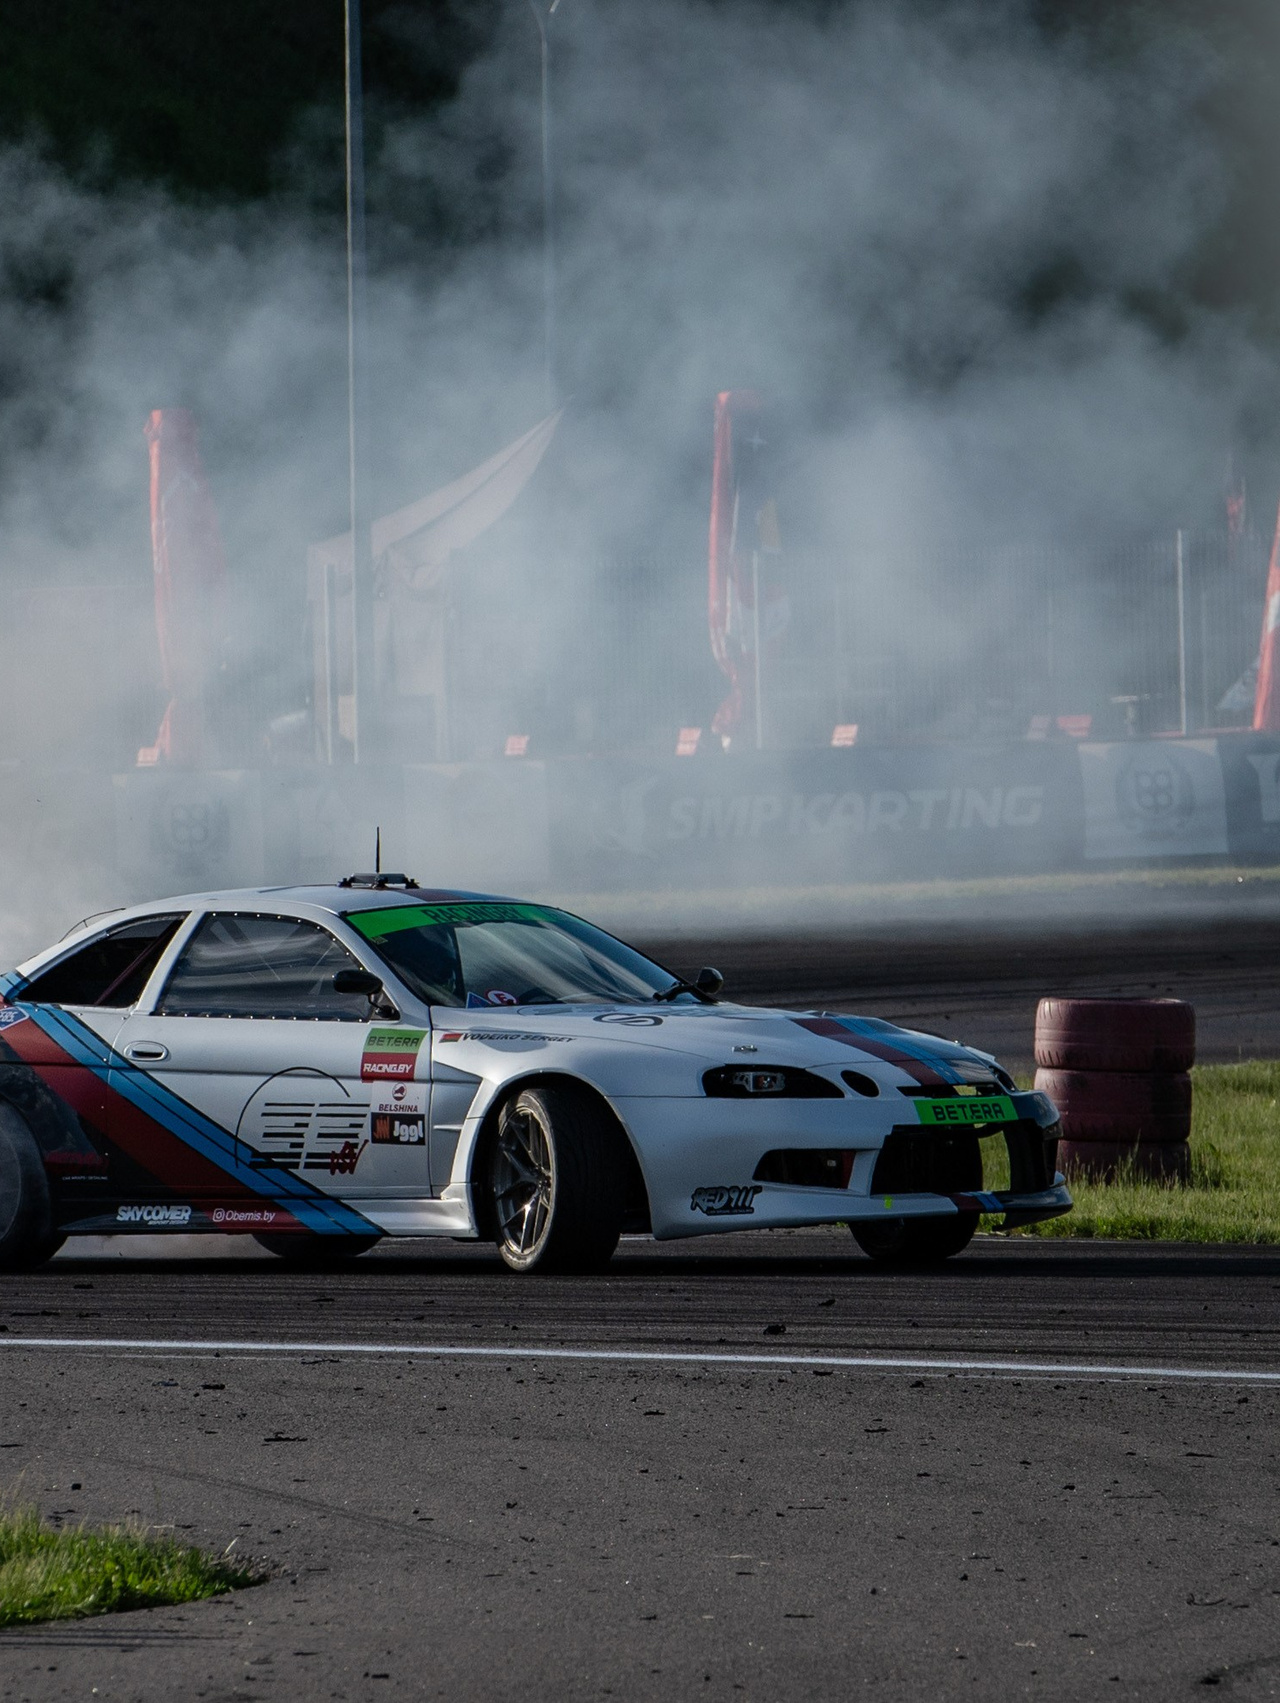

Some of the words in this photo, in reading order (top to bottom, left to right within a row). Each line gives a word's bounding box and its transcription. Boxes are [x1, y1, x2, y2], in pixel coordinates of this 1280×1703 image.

[787, 786, 1045, 835] KARTING
[379, 1103, 418, 1112] BELSHINA
[116, 1206, 191, 1221] SKYCOMER
